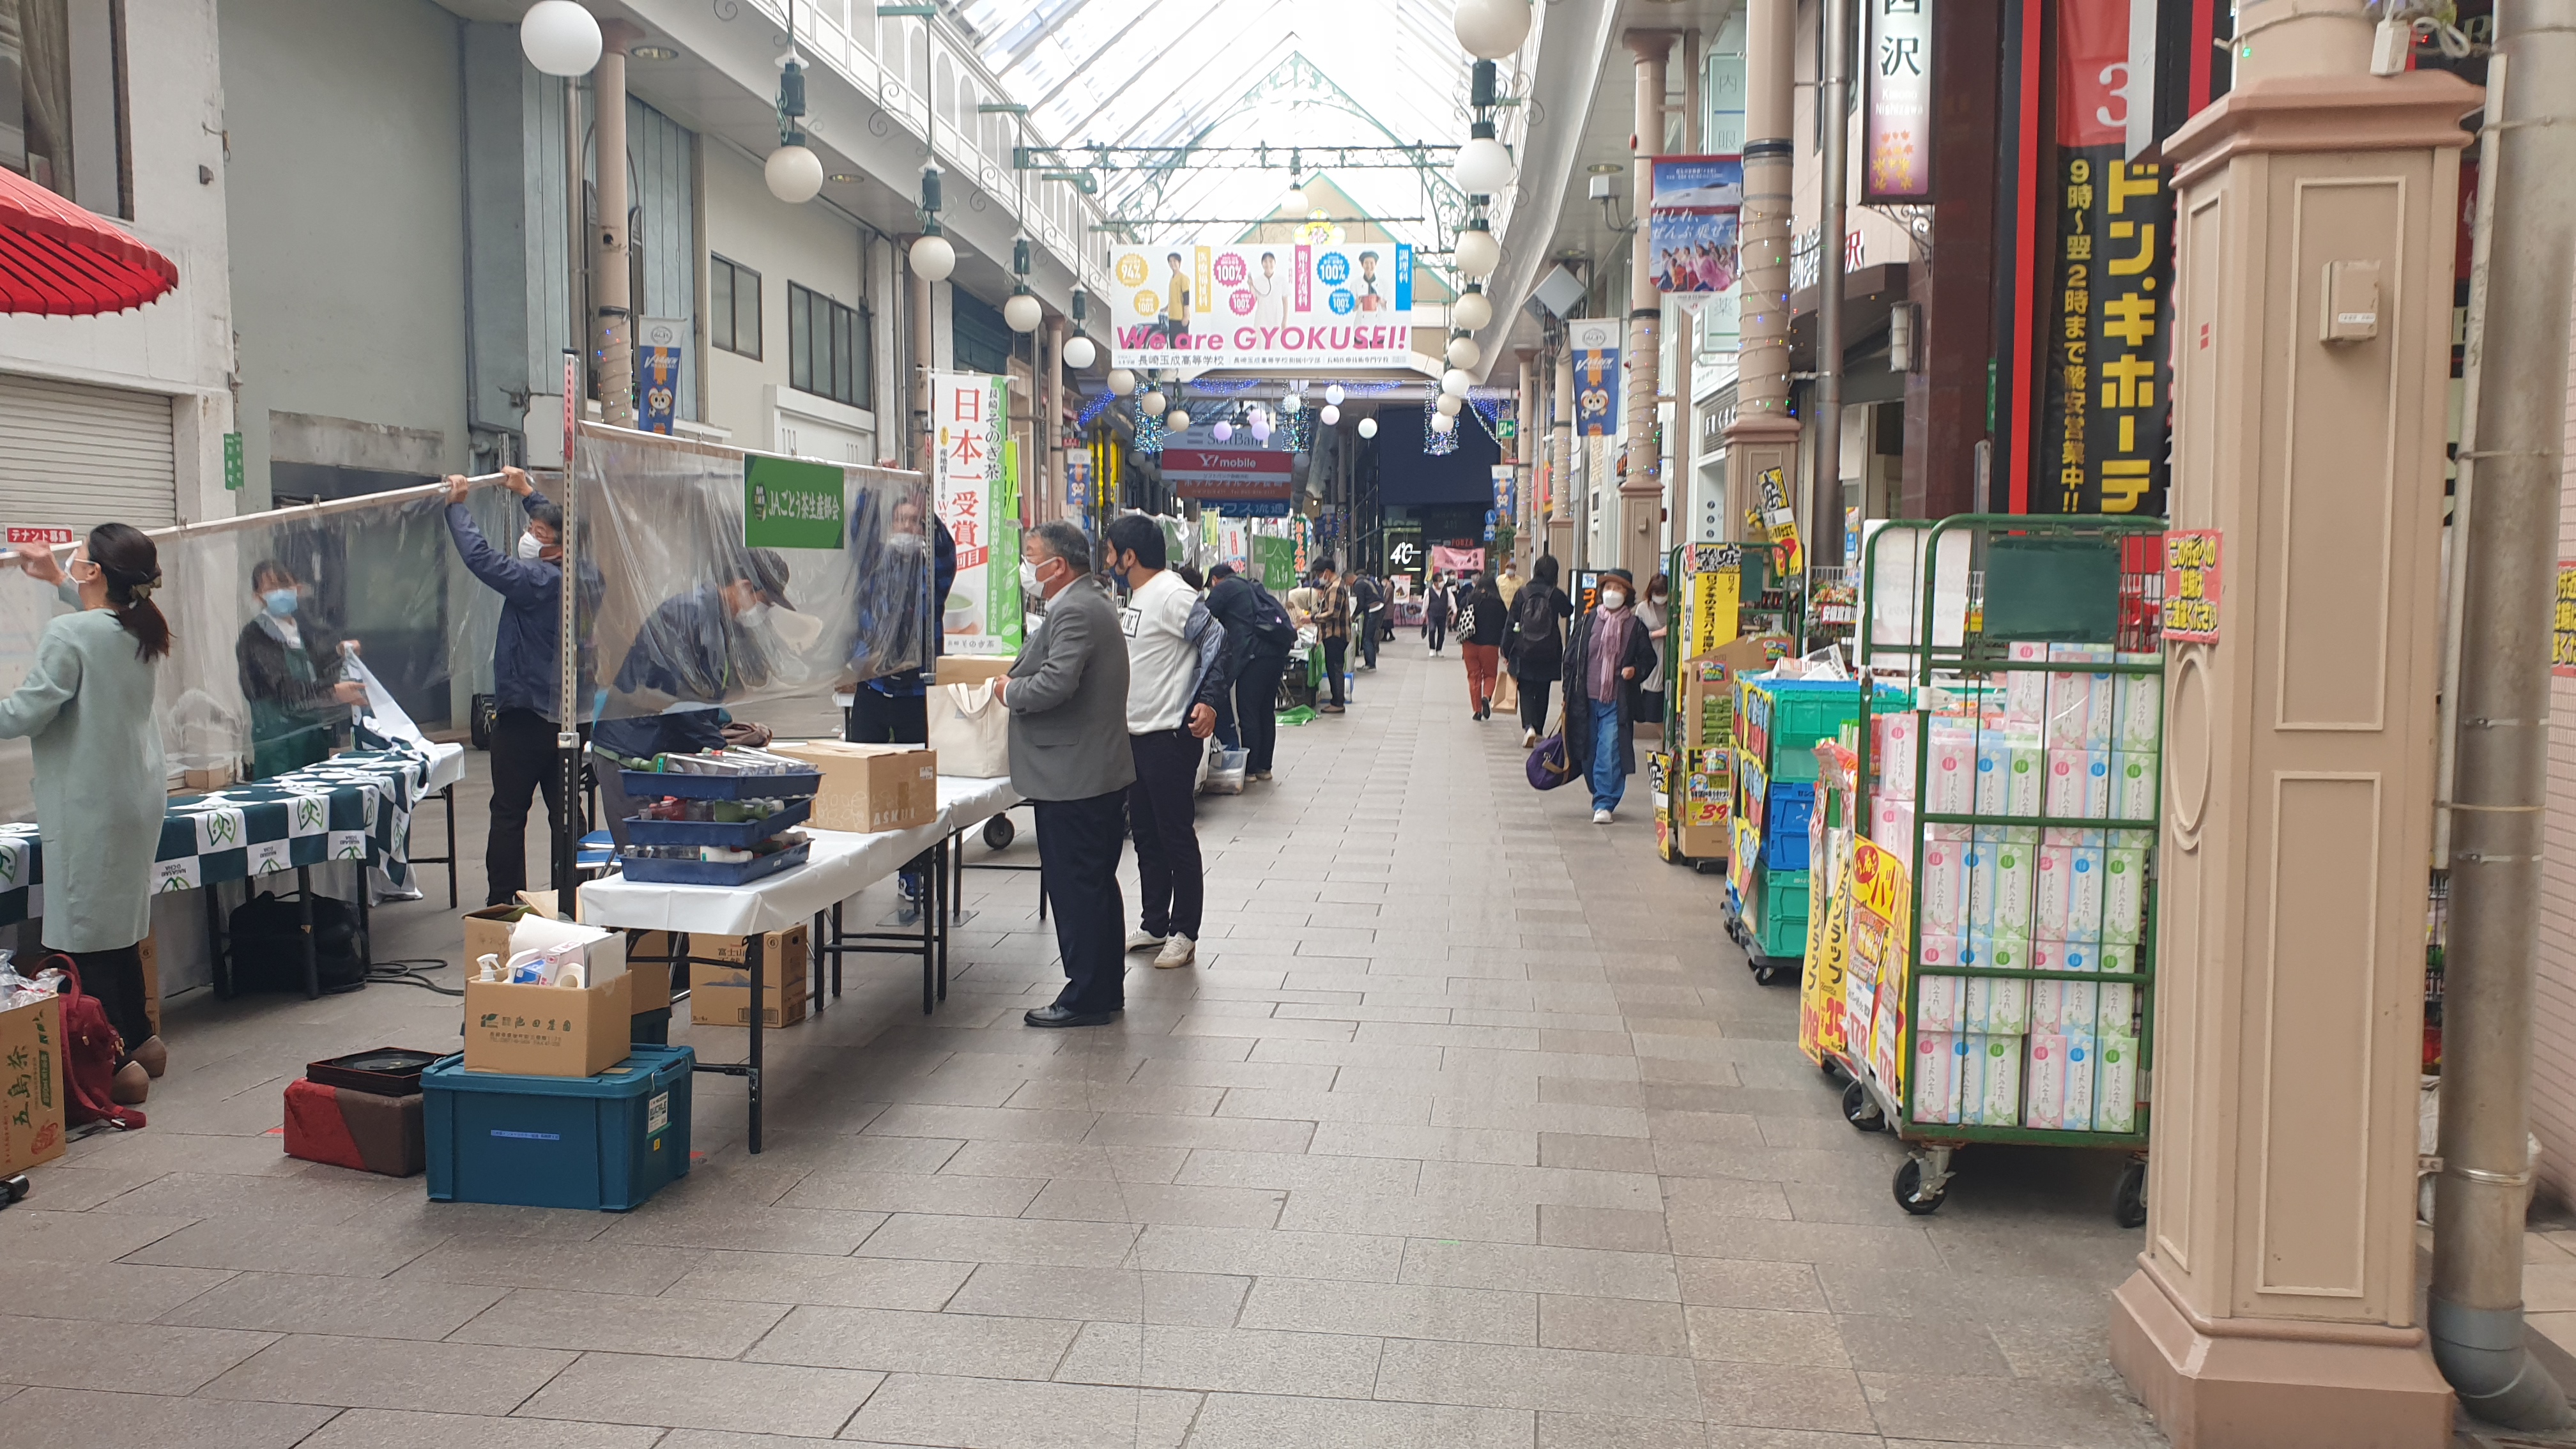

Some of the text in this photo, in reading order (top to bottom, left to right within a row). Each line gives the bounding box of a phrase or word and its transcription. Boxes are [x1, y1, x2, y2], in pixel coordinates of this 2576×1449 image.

[1216, 265, 1242, 281] 100%
[1320, 264, 1346, 280] 100%
[1233, 298, 1250, 309] 100%
[1333, 298, 1349, 308] 100%
[1117, 326, 1167, 350] We
[1174, 333, 1224, 350] are
[950, 387, 983, 548] 日本一受賞
[11, 529, 67, 542] テナント募集
[161, 868, 187, 877] NAGASAKI
[717, 948, 745, 956] 富士山
[1850, 1011, 1867, 1058] 178
